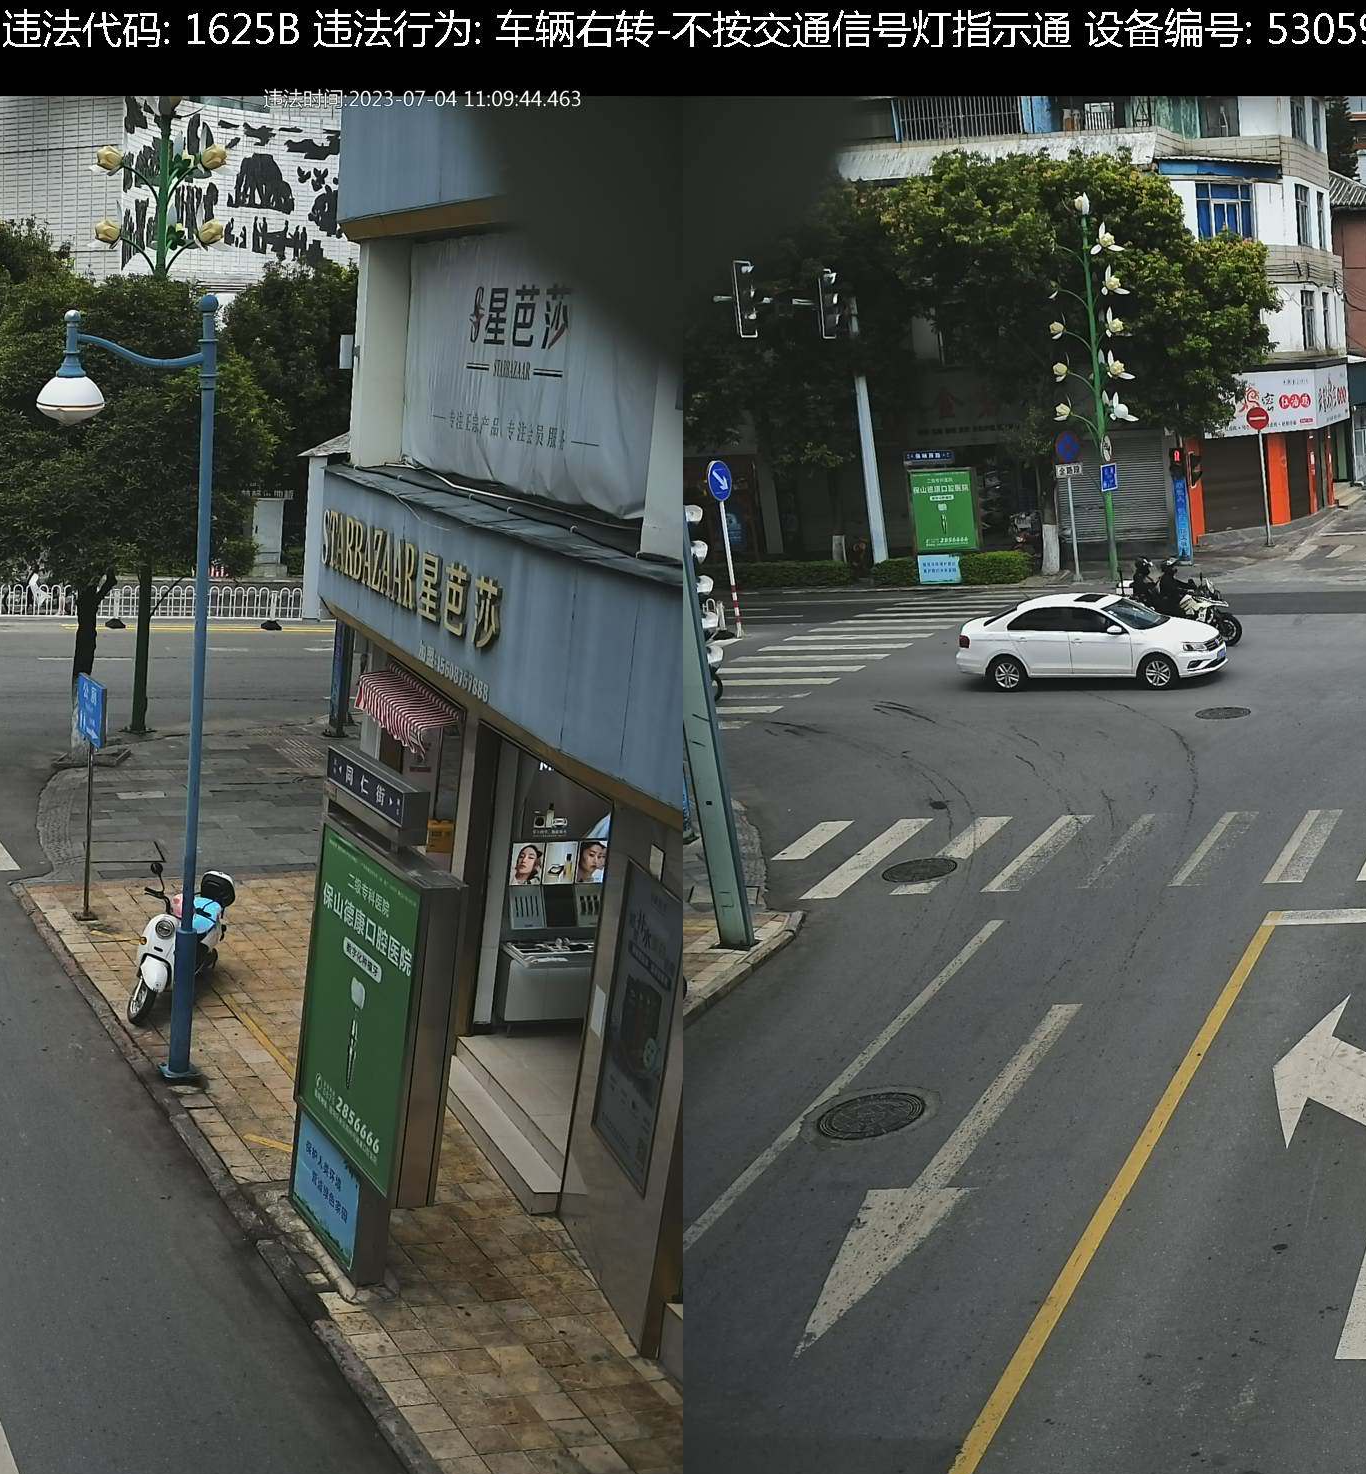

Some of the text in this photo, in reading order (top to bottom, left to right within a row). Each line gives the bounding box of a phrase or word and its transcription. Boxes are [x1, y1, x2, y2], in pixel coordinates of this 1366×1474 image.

[484, 283, 575, 350] 星芭莎
[321, 508, 503, 649] STARBAZAAR 星芭莎
[345, 764, 386, 807] 同仁街
[347, 873, 391, 918] 二级专科医院
[322, 881, 413, 977] 保山德康口腔医院
[335, 1096, 380, 1154] 2856666
